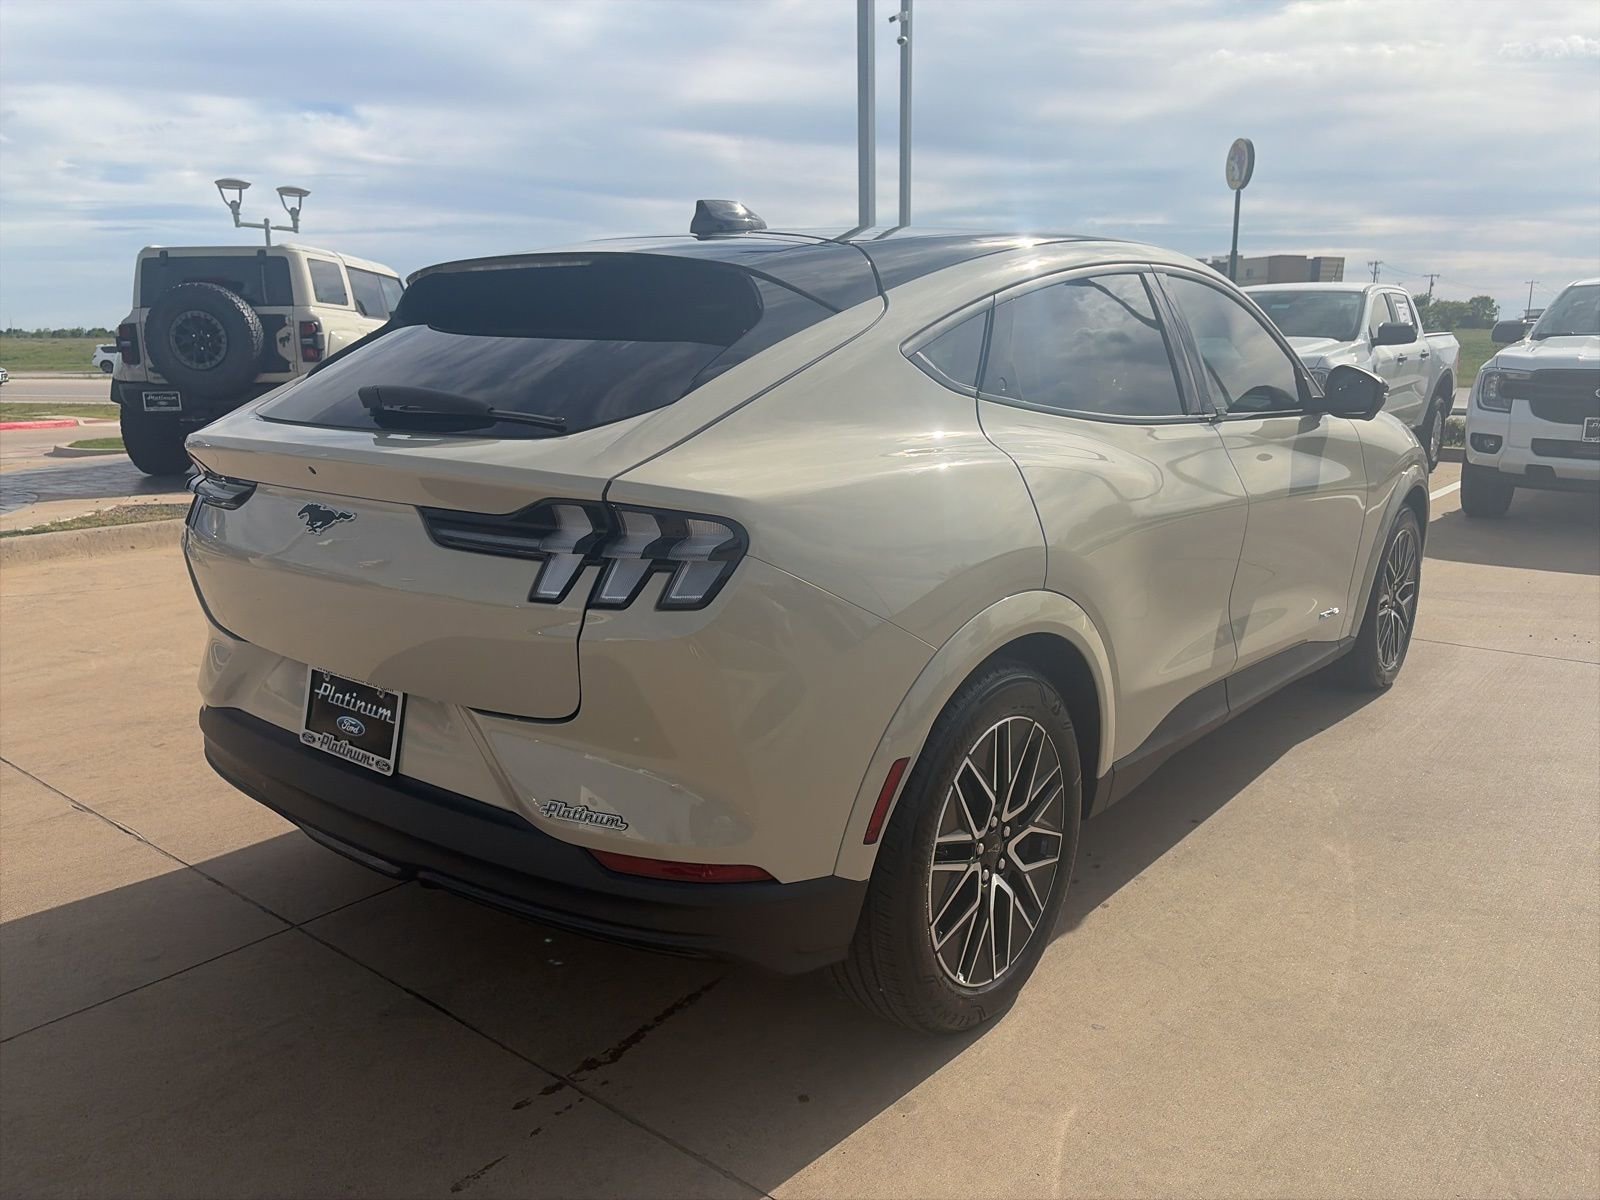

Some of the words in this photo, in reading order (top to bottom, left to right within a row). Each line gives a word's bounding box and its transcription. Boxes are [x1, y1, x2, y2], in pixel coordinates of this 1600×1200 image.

[314, 682, 395, 724] Platinum
[341, 718, 360, 734] Ford
[320, 734, 374, 767] Platinum
[541, 800, 628, 831] Platinum
